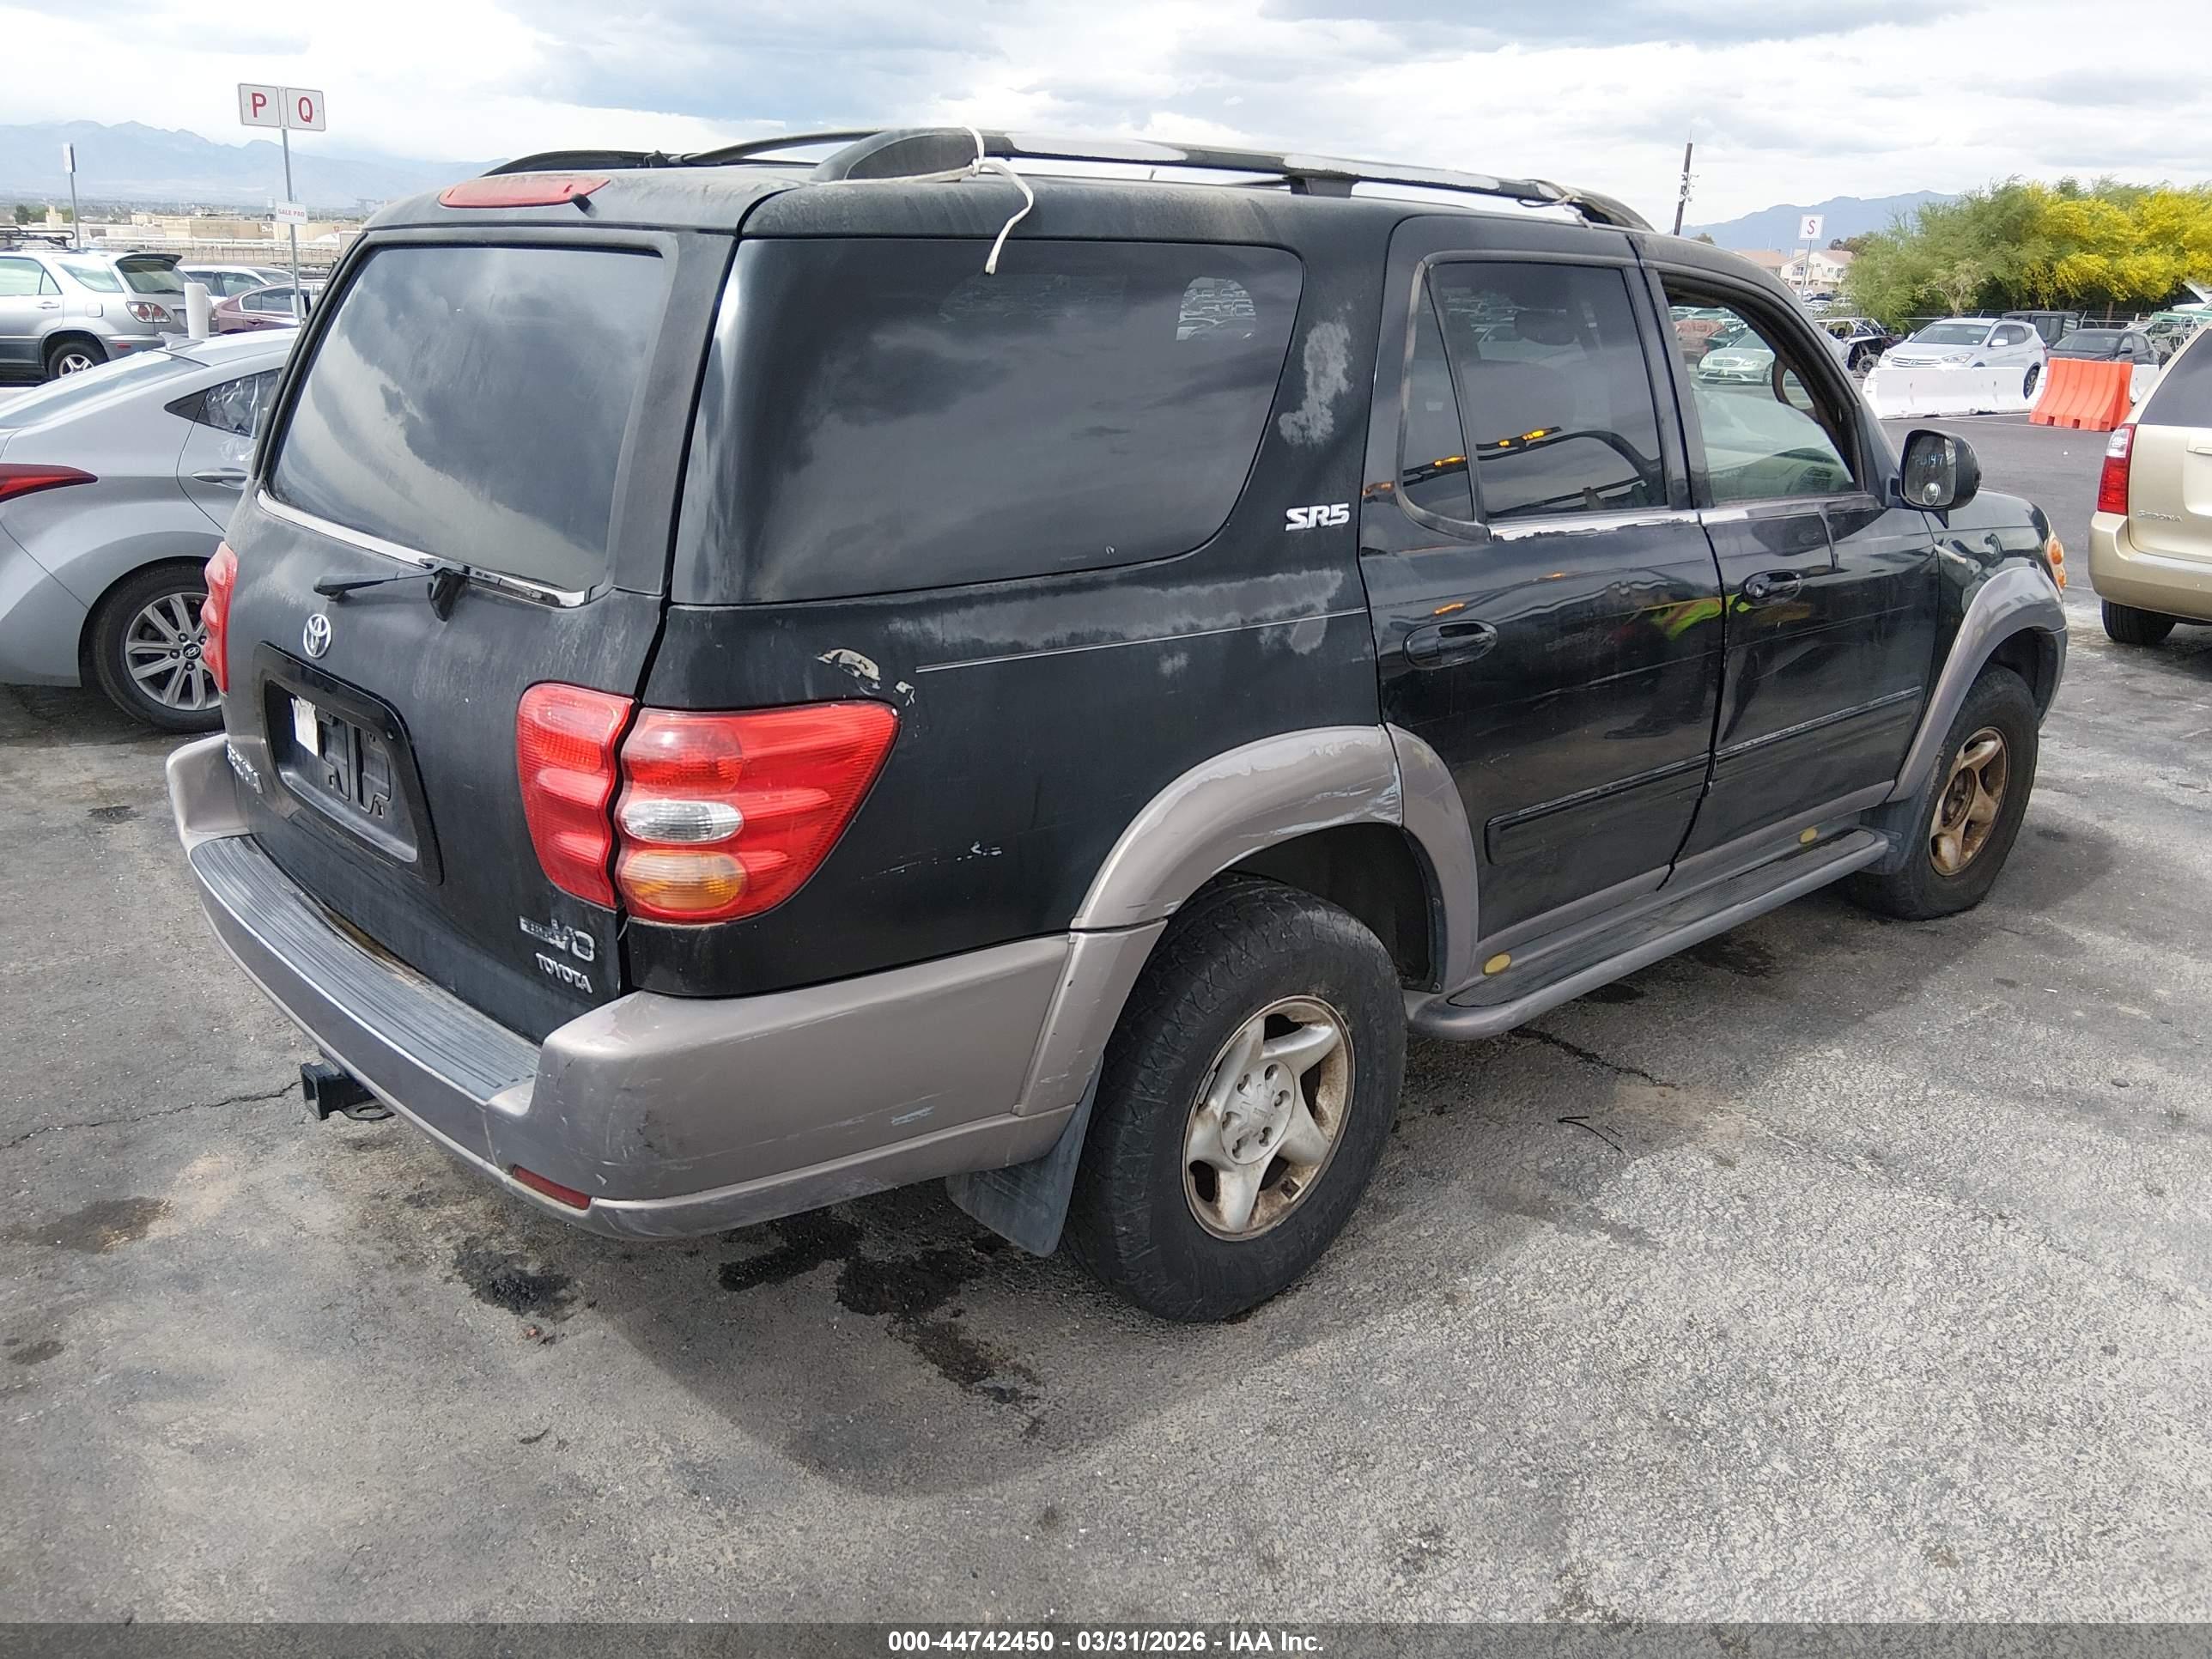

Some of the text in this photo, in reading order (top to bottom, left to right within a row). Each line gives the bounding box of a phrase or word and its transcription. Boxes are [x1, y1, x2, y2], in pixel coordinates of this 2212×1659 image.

[252, 92, 267, 118] P
[298, 96, 313, 124] Q
[277, 208, 291, 216] SALE
[1807, 219, 1816, 235] S
[1285, 502, 1350, 532] SR5
[535, 952, 593, 994] TOYOTA
